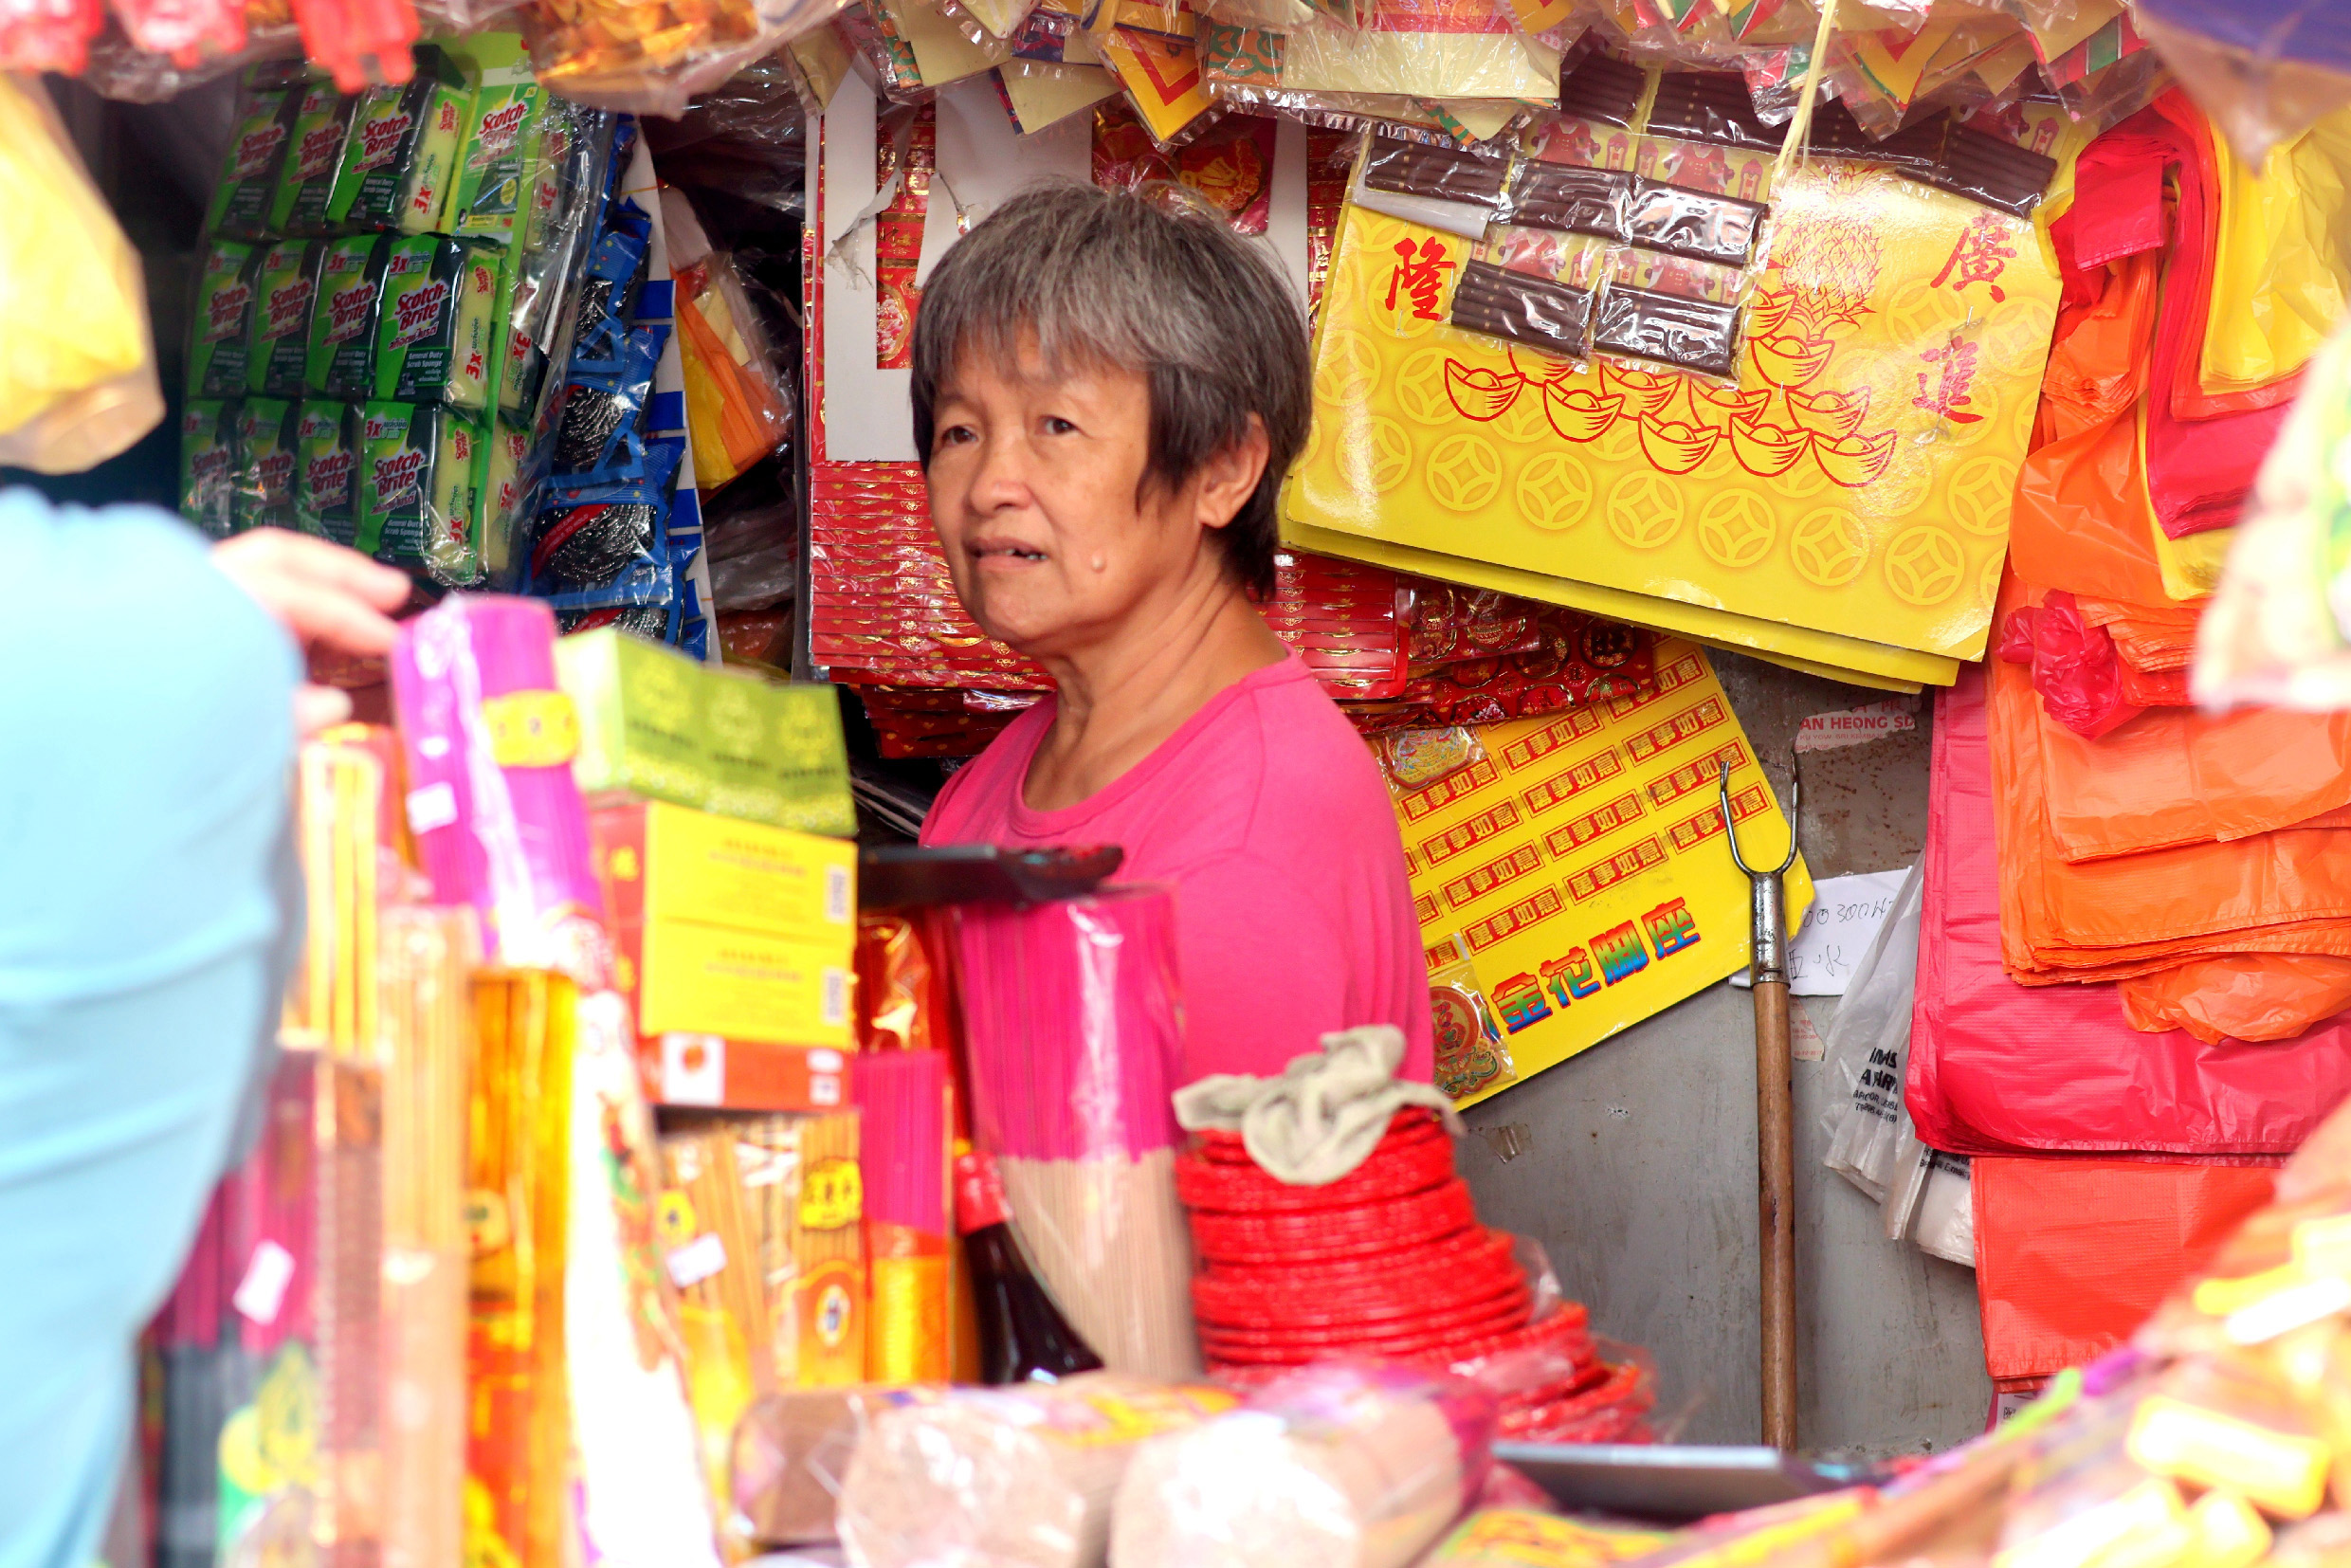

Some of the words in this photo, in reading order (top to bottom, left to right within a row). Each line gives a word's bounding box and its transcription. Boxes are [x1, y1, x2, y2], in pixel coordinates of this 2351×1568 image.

[364, 133, 402, 157] Brite
[389, 254, 410, 274] 3x
[1384, 236, 1458, 322] 隆
[331, 302, 368, 330] Brite
[399, 302, 440, 332] Brite
[428, 349, 445, 362] Duty
[375, 470, 416, 497] Brite
[1507, 713, 1597, 767] 萬事如意
[1631, 702, 1722, 758] 萬事如意
[1831, 716, 1888, 730] HEONG
[1405, 762, 1495, 819] 萬事如意
[1529, 751, 1618, 809] 萬事如意
[1655, 744, 1743, 803] 萬事如意
[1428, 803, 1517, 861] 萬事如意
[1551, 796, 1642, 854] 萬事如意
[1449, 847, 1539, 904] 萬事如意
[1570, 840, 1661, 897] 萬事如意
[1469, 890, 1559, 947] 萬事如意
